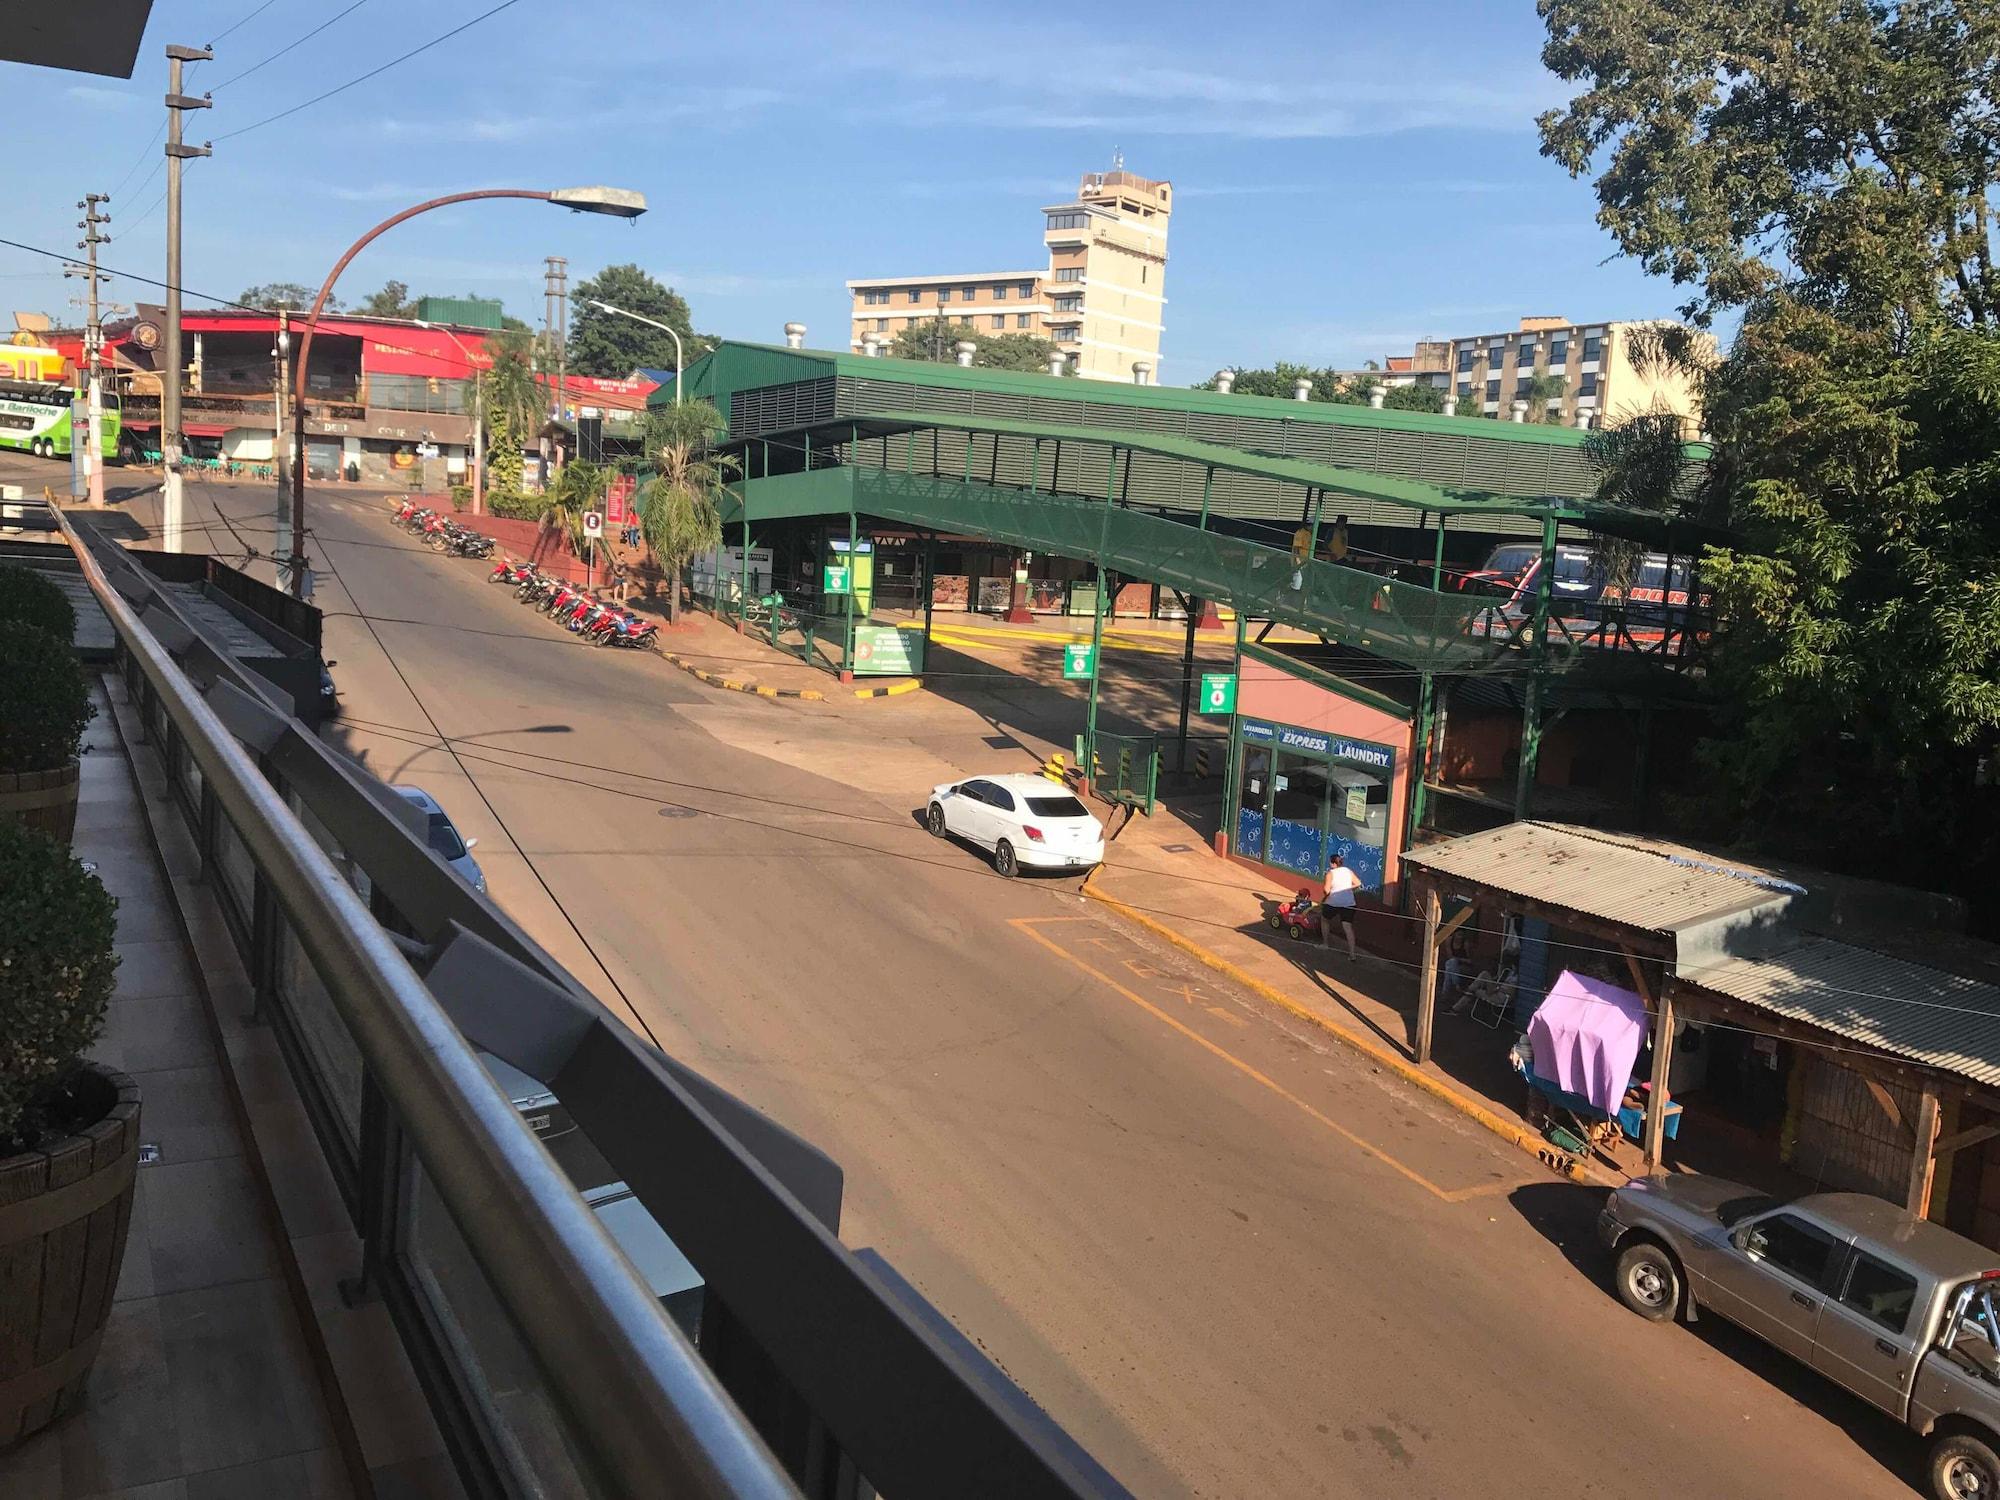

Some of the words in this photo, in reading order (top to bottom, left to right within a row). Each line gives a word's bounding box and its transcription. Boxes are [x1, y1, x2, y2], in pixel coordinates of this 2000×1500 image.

[8, 402, 58, 416] Bariloche
[1243, 724, 1272, 736] LAVANDERIA
[1282, 733, 1328, 751] EXPRESS
[1338, 745, 1390, 767] LAUNDRY
